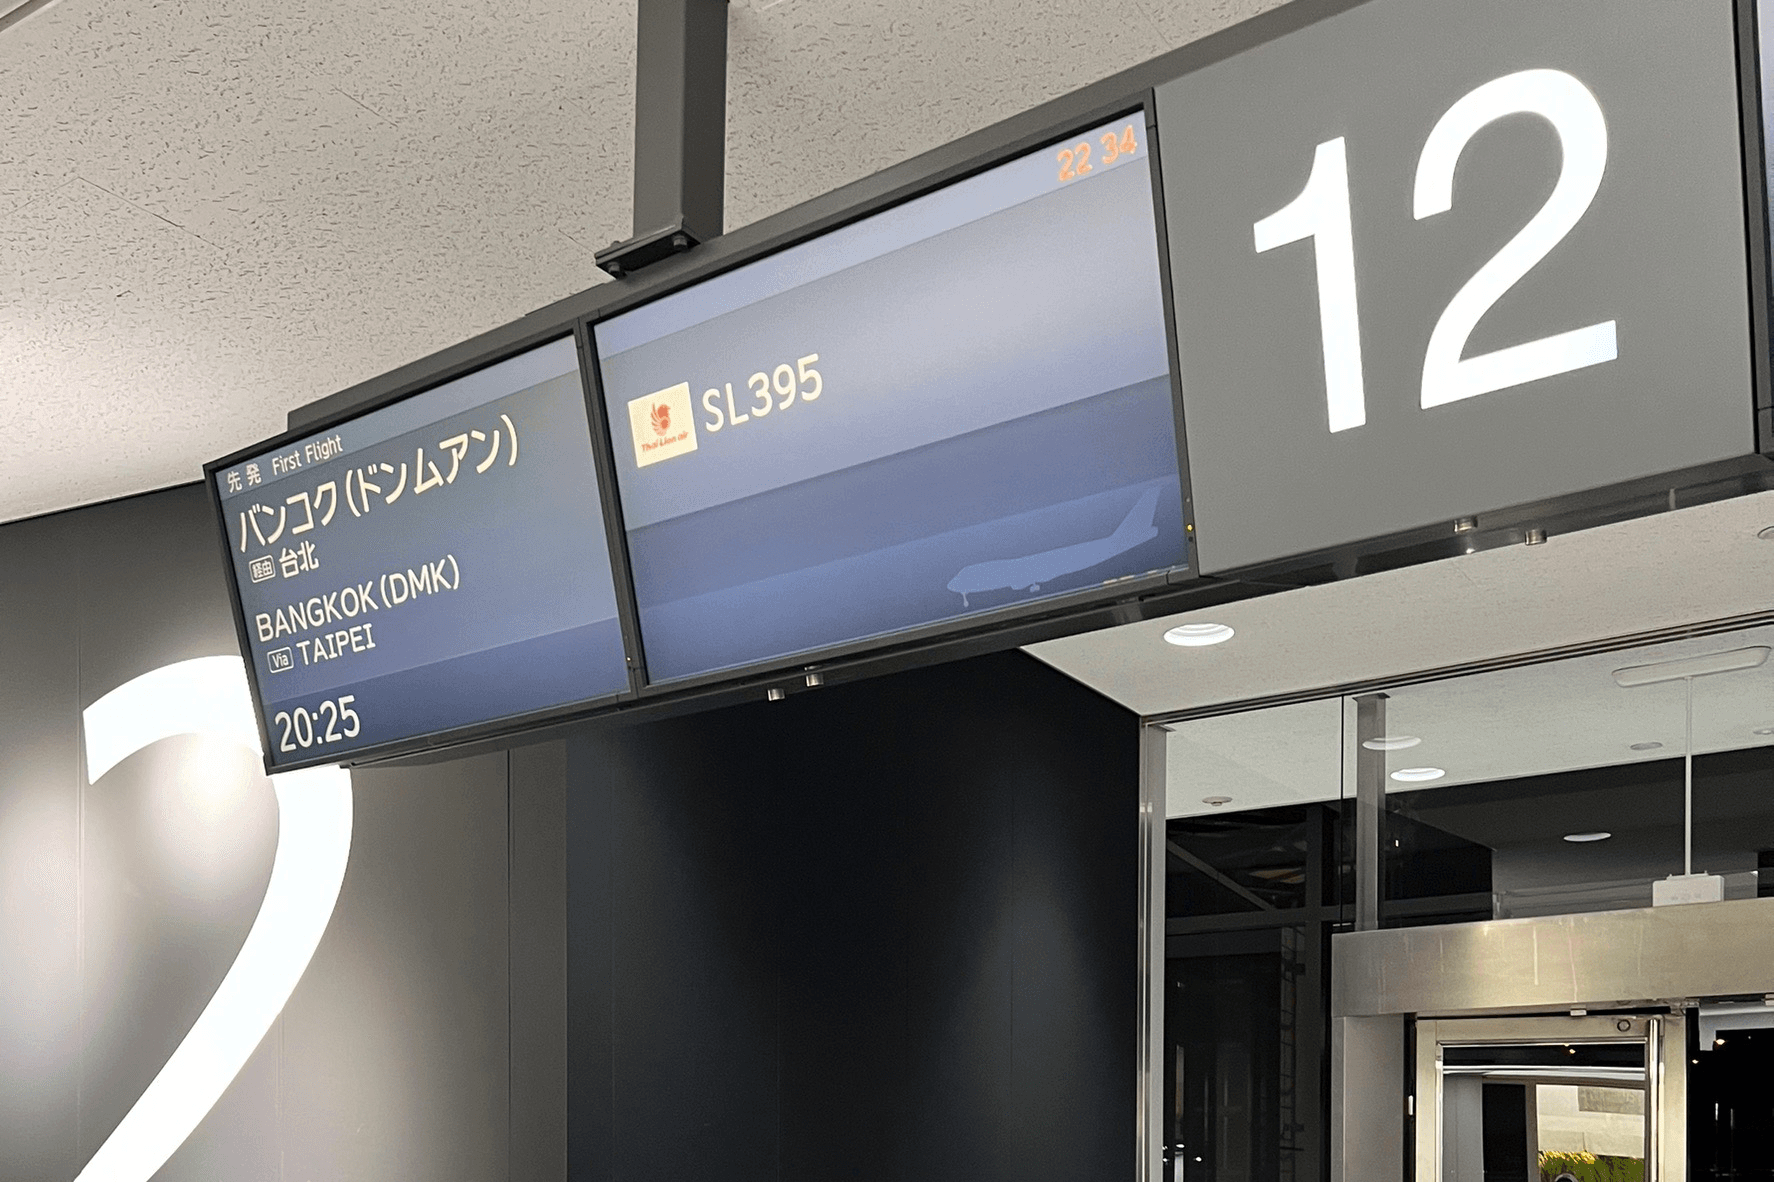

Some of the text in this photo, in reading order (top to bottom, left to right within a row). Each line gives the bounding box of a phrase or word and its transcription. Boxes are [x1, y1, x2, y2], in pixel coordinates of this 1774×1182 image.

[1057, 142, 1093, 182] 22
[1253, 68, 1618, 434] 12
[702, 353, 823, 433] SL395
[272, 450, 303, 476] First
[304, 435, 344, 464] Flight
[279, 540, 320, 579] 台北
[272, 623, 377, 669] Via TAIPEI
[274, 694, 361, 753] 20:25
